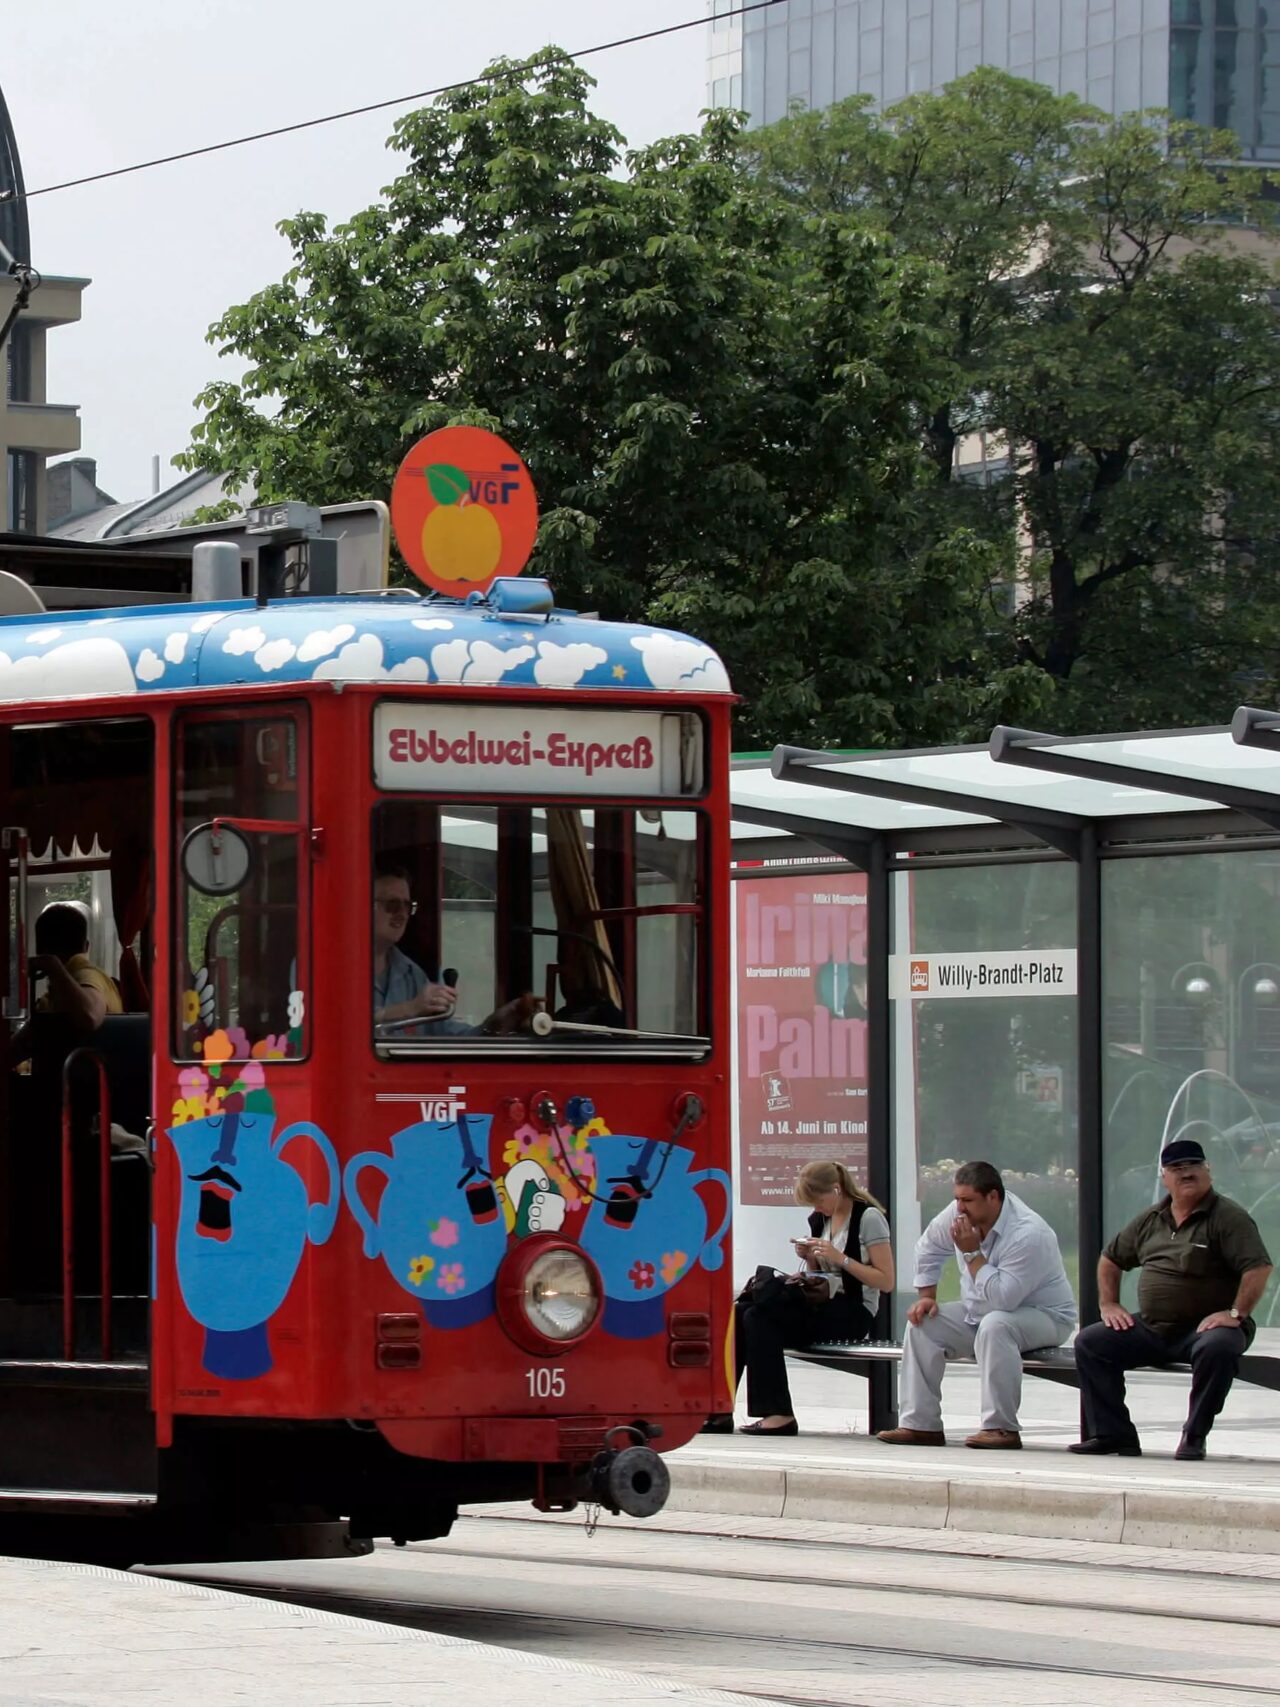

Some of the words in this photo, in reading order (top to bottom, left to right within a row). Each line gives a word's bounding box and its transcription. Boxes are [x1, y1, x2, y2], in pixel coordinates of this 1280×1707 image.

[469, 464, 519, 505] VGF
[389, 729, 654, 776] Ebbelwei-Expreß
[938, 963, 1064, 988] Willy-Brandt-Platz
[420, 1086, 466, 1122] VGF
[761, 1121, 774, 1134] Ab
[778, 1121, 793, 1134] 14.
[796, 1120, 820, 1134] Juni
[823, 1120, 837, 1134] im
[525, 1368, 566, 1397] 105
